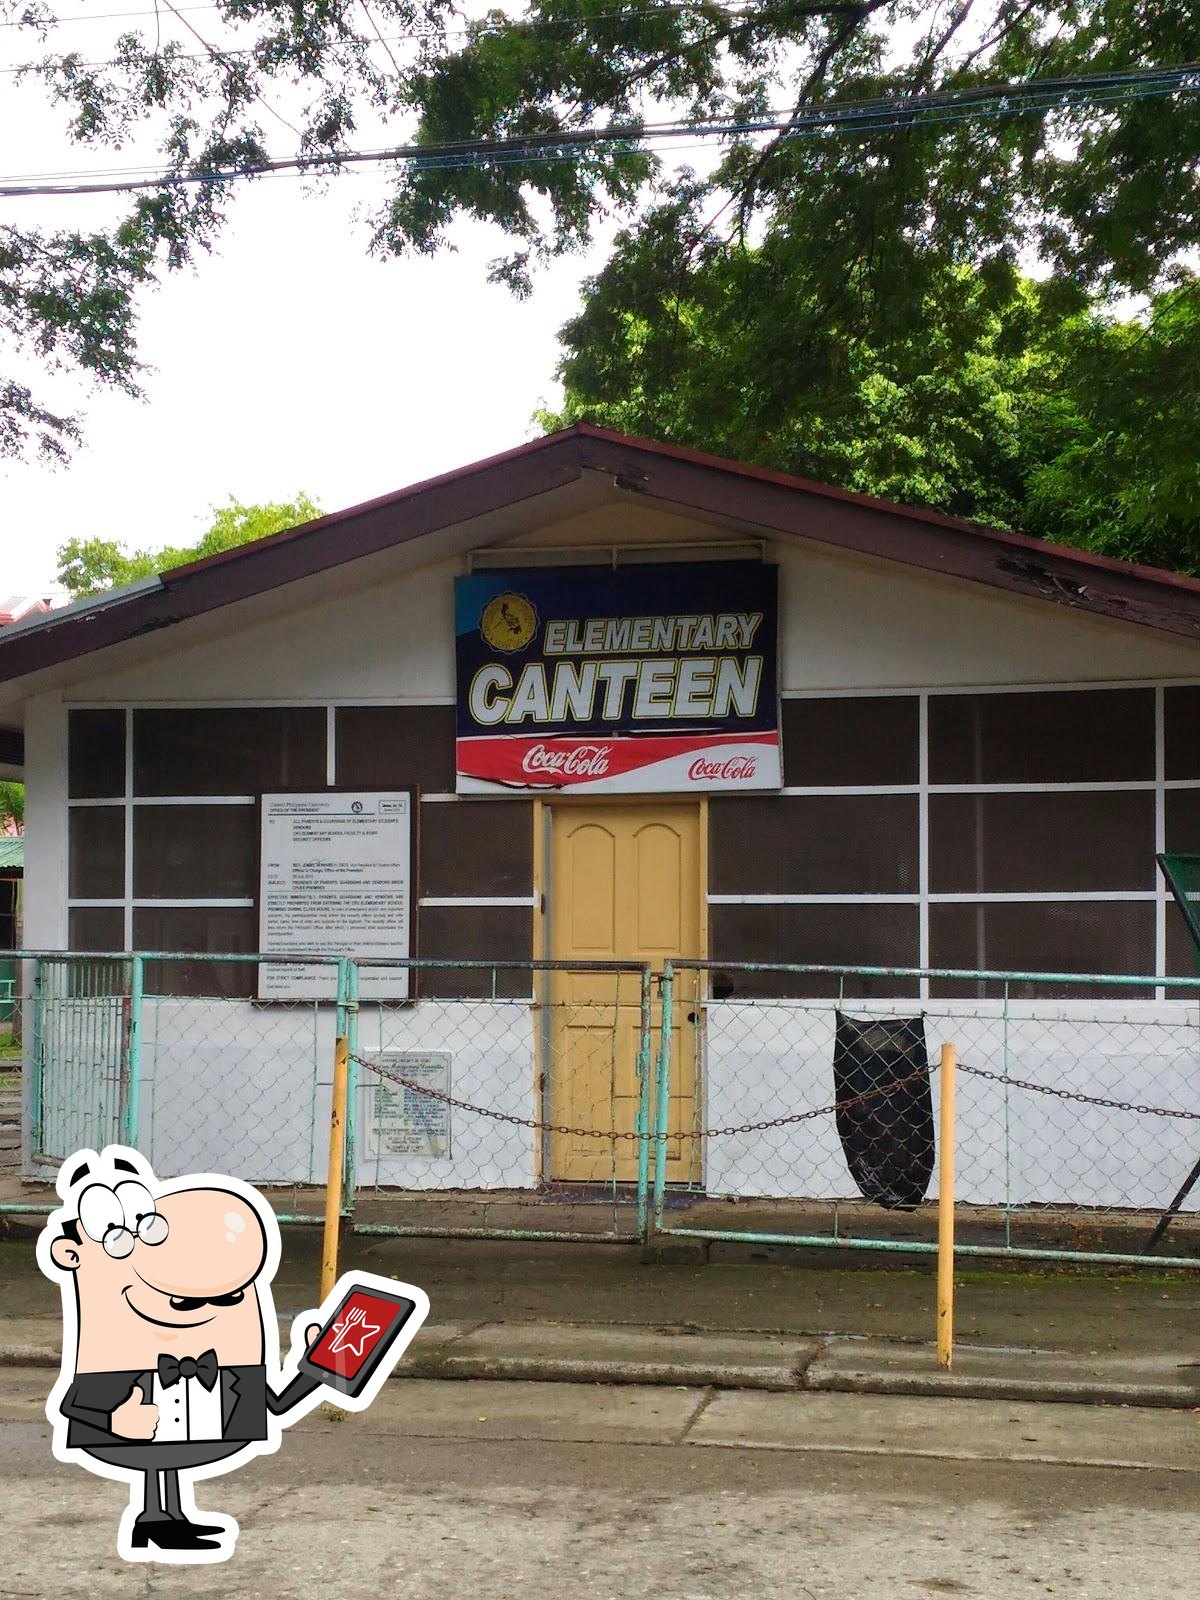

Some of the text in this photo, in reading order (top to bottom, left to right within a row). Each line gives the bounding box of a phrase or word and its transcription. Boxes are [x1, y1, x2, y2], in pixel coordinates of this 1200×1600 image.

[545, 613, 762, 655] ELEMENTARY
[470, 657, 763, 725] CANTEEN
[522, 744, 612, 776] Coca-Cola
[688, 757, 758, 781] Coca-Cola
